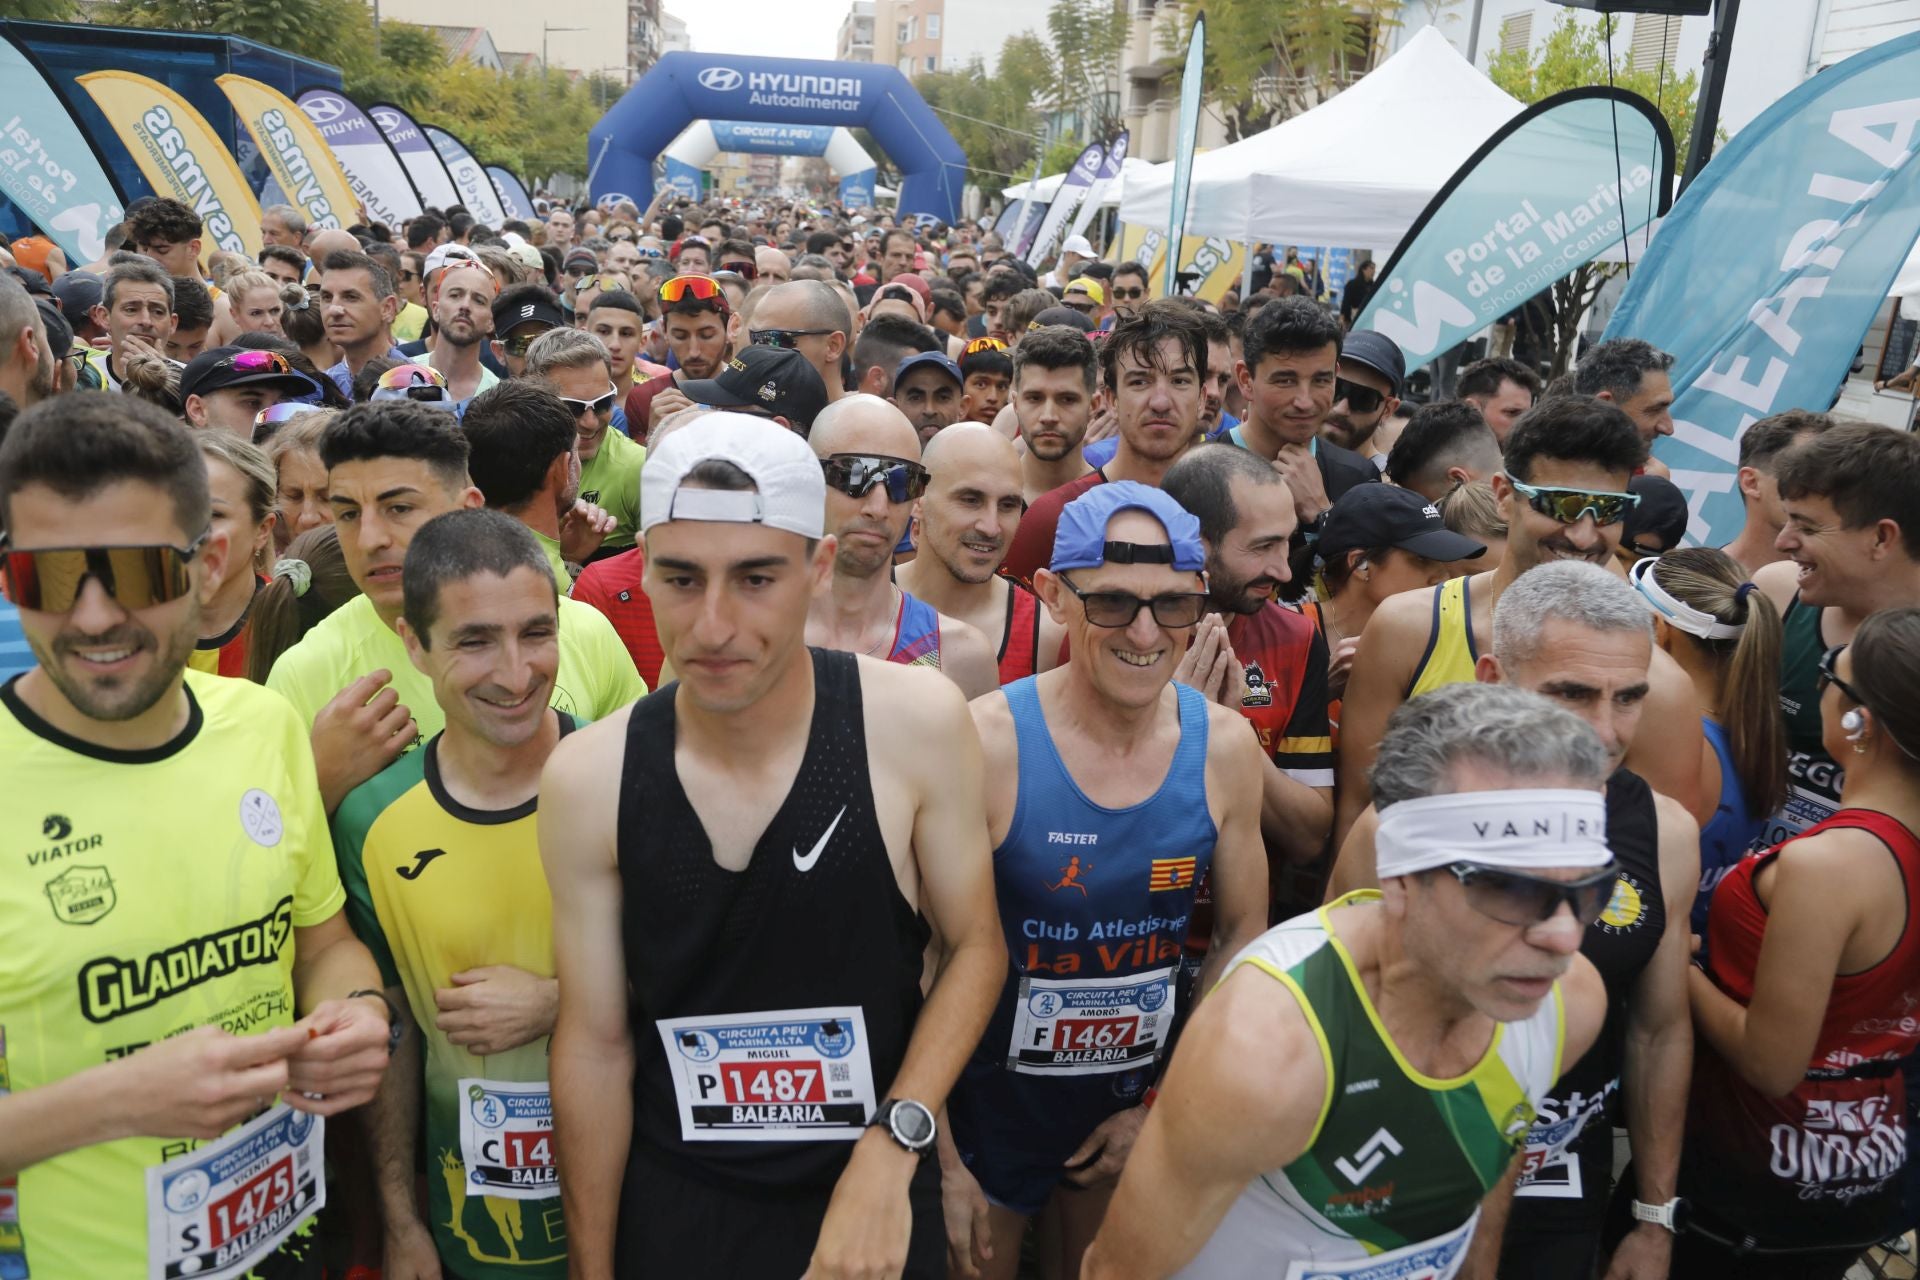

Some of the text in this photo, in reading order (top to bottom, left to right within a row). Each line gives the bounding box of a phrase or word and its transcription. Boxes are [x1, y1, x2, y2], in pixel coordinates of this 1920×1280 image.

[749, 72, 861, 97] HYUNDAI
[750, 91, 860, 111] Autoalmenar
[732, 126, 812, 139] CIRCUIT A PEU
[1444, 199, 1541, 276] Portal
[1466, 164, 1654, 298] de la Marina
[1048, 832, 1098, 845] FASTER
[1473, 821, 1550, 838] VAN
[28, 834, 104, 866] VIATOR
[1022, 918, 1079, 941] Club
[80, 900, 291, 1022] GLADIATORS
[1027, 934, 1181, 975] La Vila
[1066, 991, 1105, 1000] CIRCUIT
[1105, 990, 1115, 998] A
[1117, 988, 1139, 998] PEU
[1071, 997, 1131, 1006] MARINA ALTA
[1079, 1007, 1120, 1017] AMORÓS
[718, 1026, 808, 1039] CIRCUIT A PEU
[728, 1037, 804, 1046] MARINA ALTA
[1033, 1022, 1135, 1049] F 1467
[747, 1049, 791, 1059] MIGUEL
[1053, 1047, 1129, 1063] BALEARIA
[698, 1069, 817, 1102] P 1487
[507, 1098, 551, 1107] CIRCUIT
[482, 1138, 557, 1167] C 14
[233, 1155, 271, 1187] VICENTE
[511, 1168, 559, 1184] BALE
[181, 1166, 290, 1252] S 1475
[215, 1203, 293, 1267] BALEARIA
